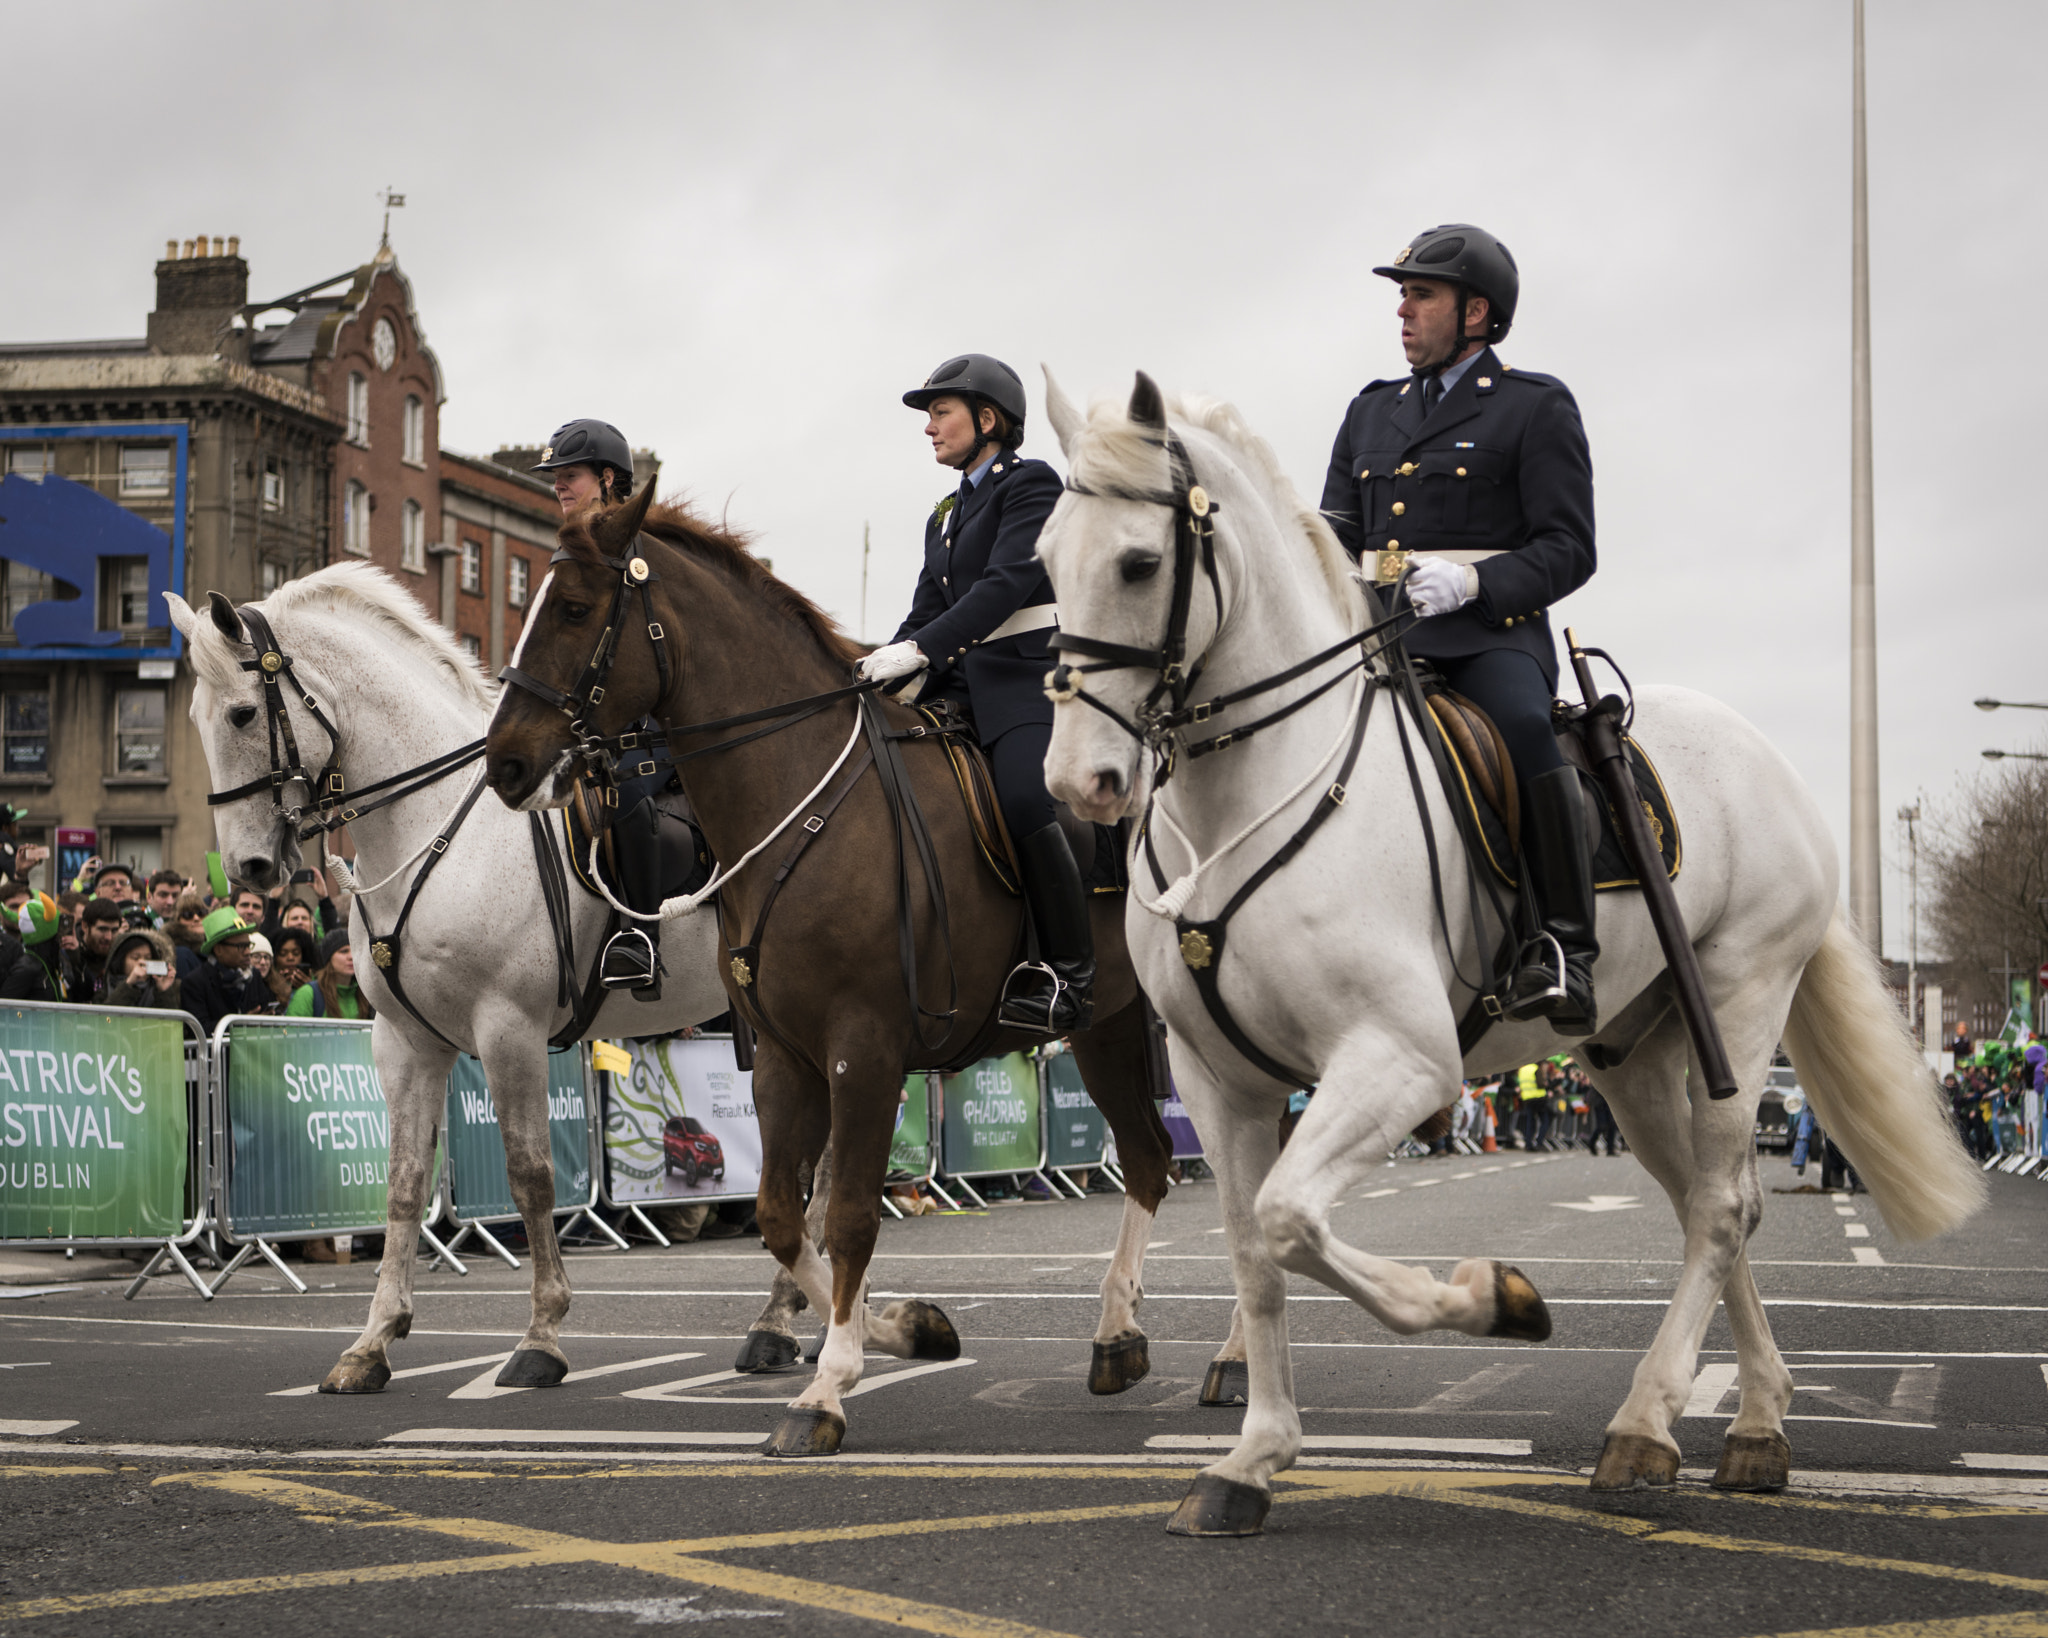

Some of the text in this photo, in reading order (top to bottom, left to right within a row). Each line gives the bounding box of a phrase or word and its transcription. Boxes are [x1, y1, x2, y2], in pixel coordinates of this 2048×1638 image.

[0, 1102, 125, 1149] STIVAL
[712, 1103, 742, 1119] Renault
[307, 1110, 391, 1151] FESTIV
[340, 1161, 390, 1187] DUBLI
